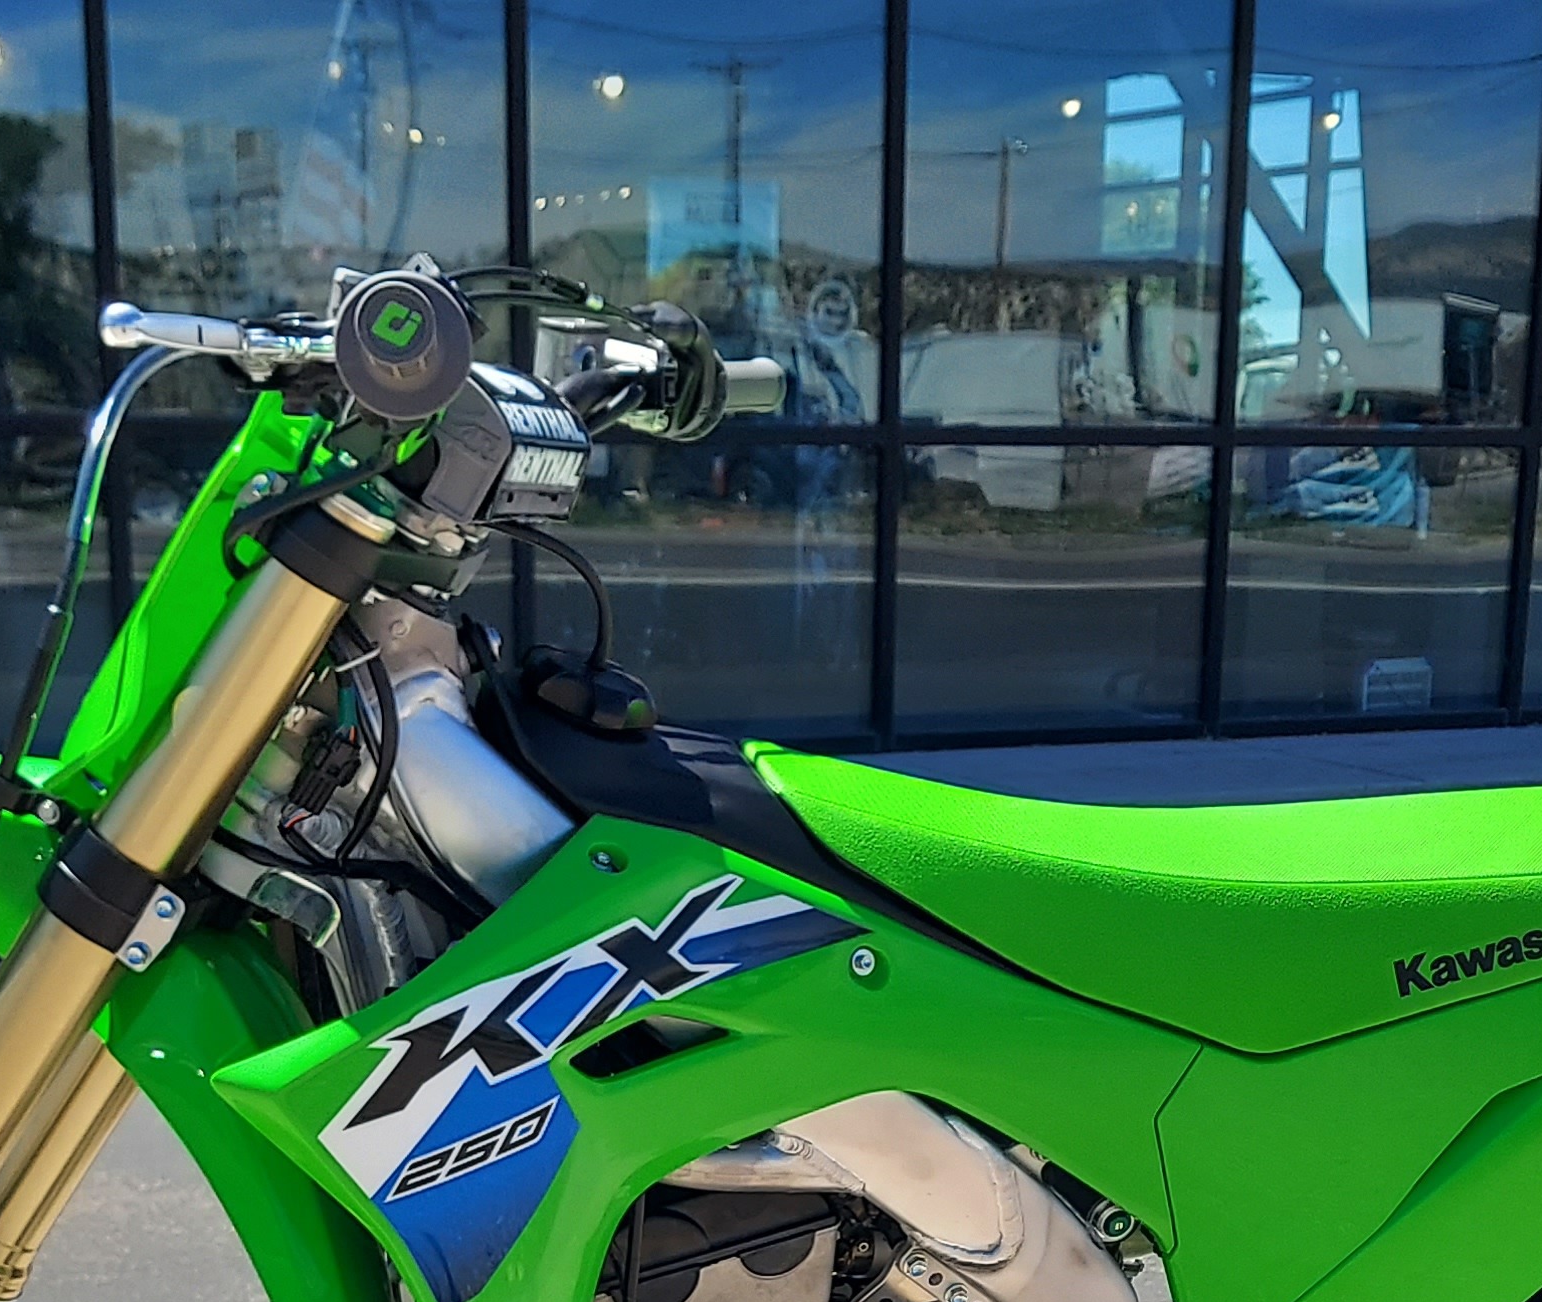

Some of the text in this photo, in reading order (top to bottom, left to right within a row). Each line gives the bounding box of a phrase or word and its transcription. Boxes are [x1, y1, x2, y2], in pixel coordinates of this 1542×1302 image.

[497, 400, 589, 443] RENTHAL
[504, 446, 585, 487] RENTHAL
[341, 876, 738, 1132] KX
[389, 1101, 556, 1199] 250
